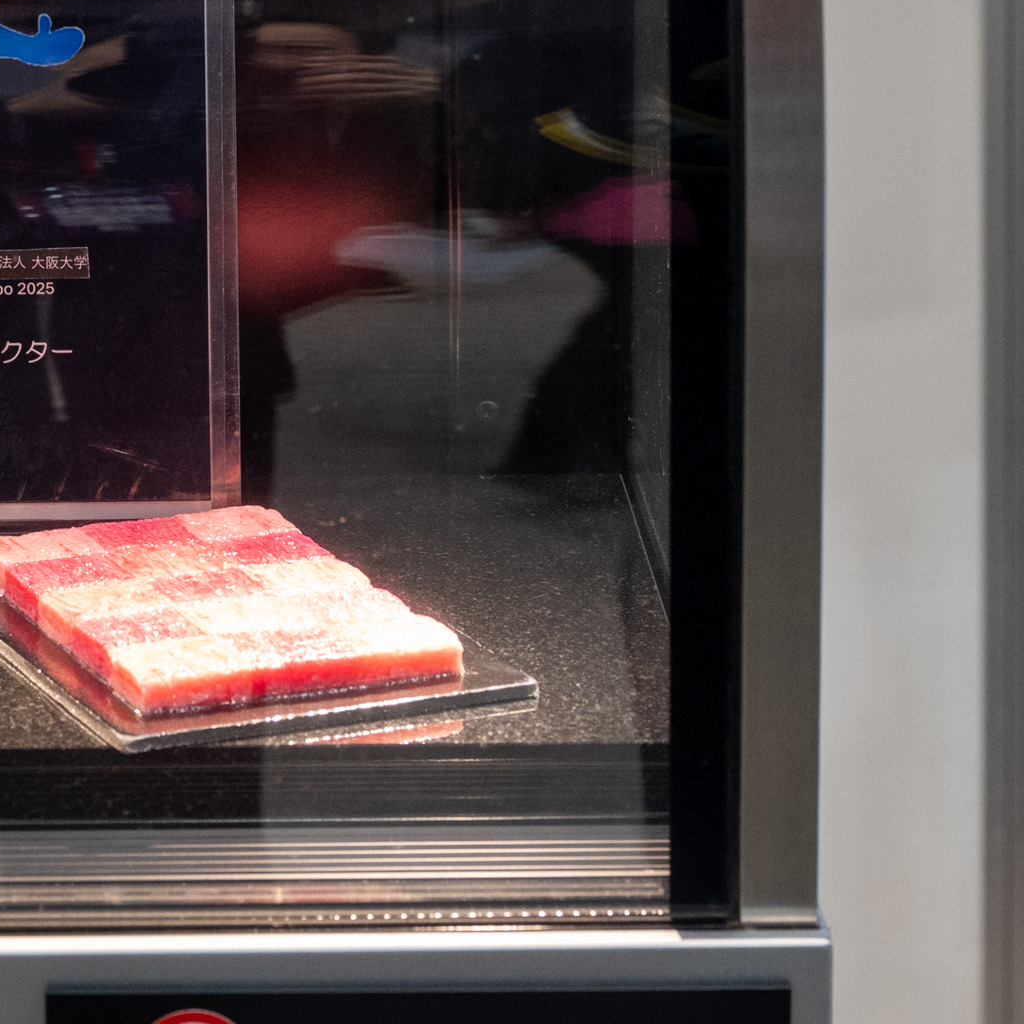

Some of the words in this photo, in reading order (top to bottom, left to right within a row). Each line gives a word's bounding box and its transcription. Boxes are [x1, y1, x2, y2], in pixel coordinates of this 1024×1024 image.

[31, 254, 88, 270] 大阪大学
[18, 281, 55, 295] 2025
